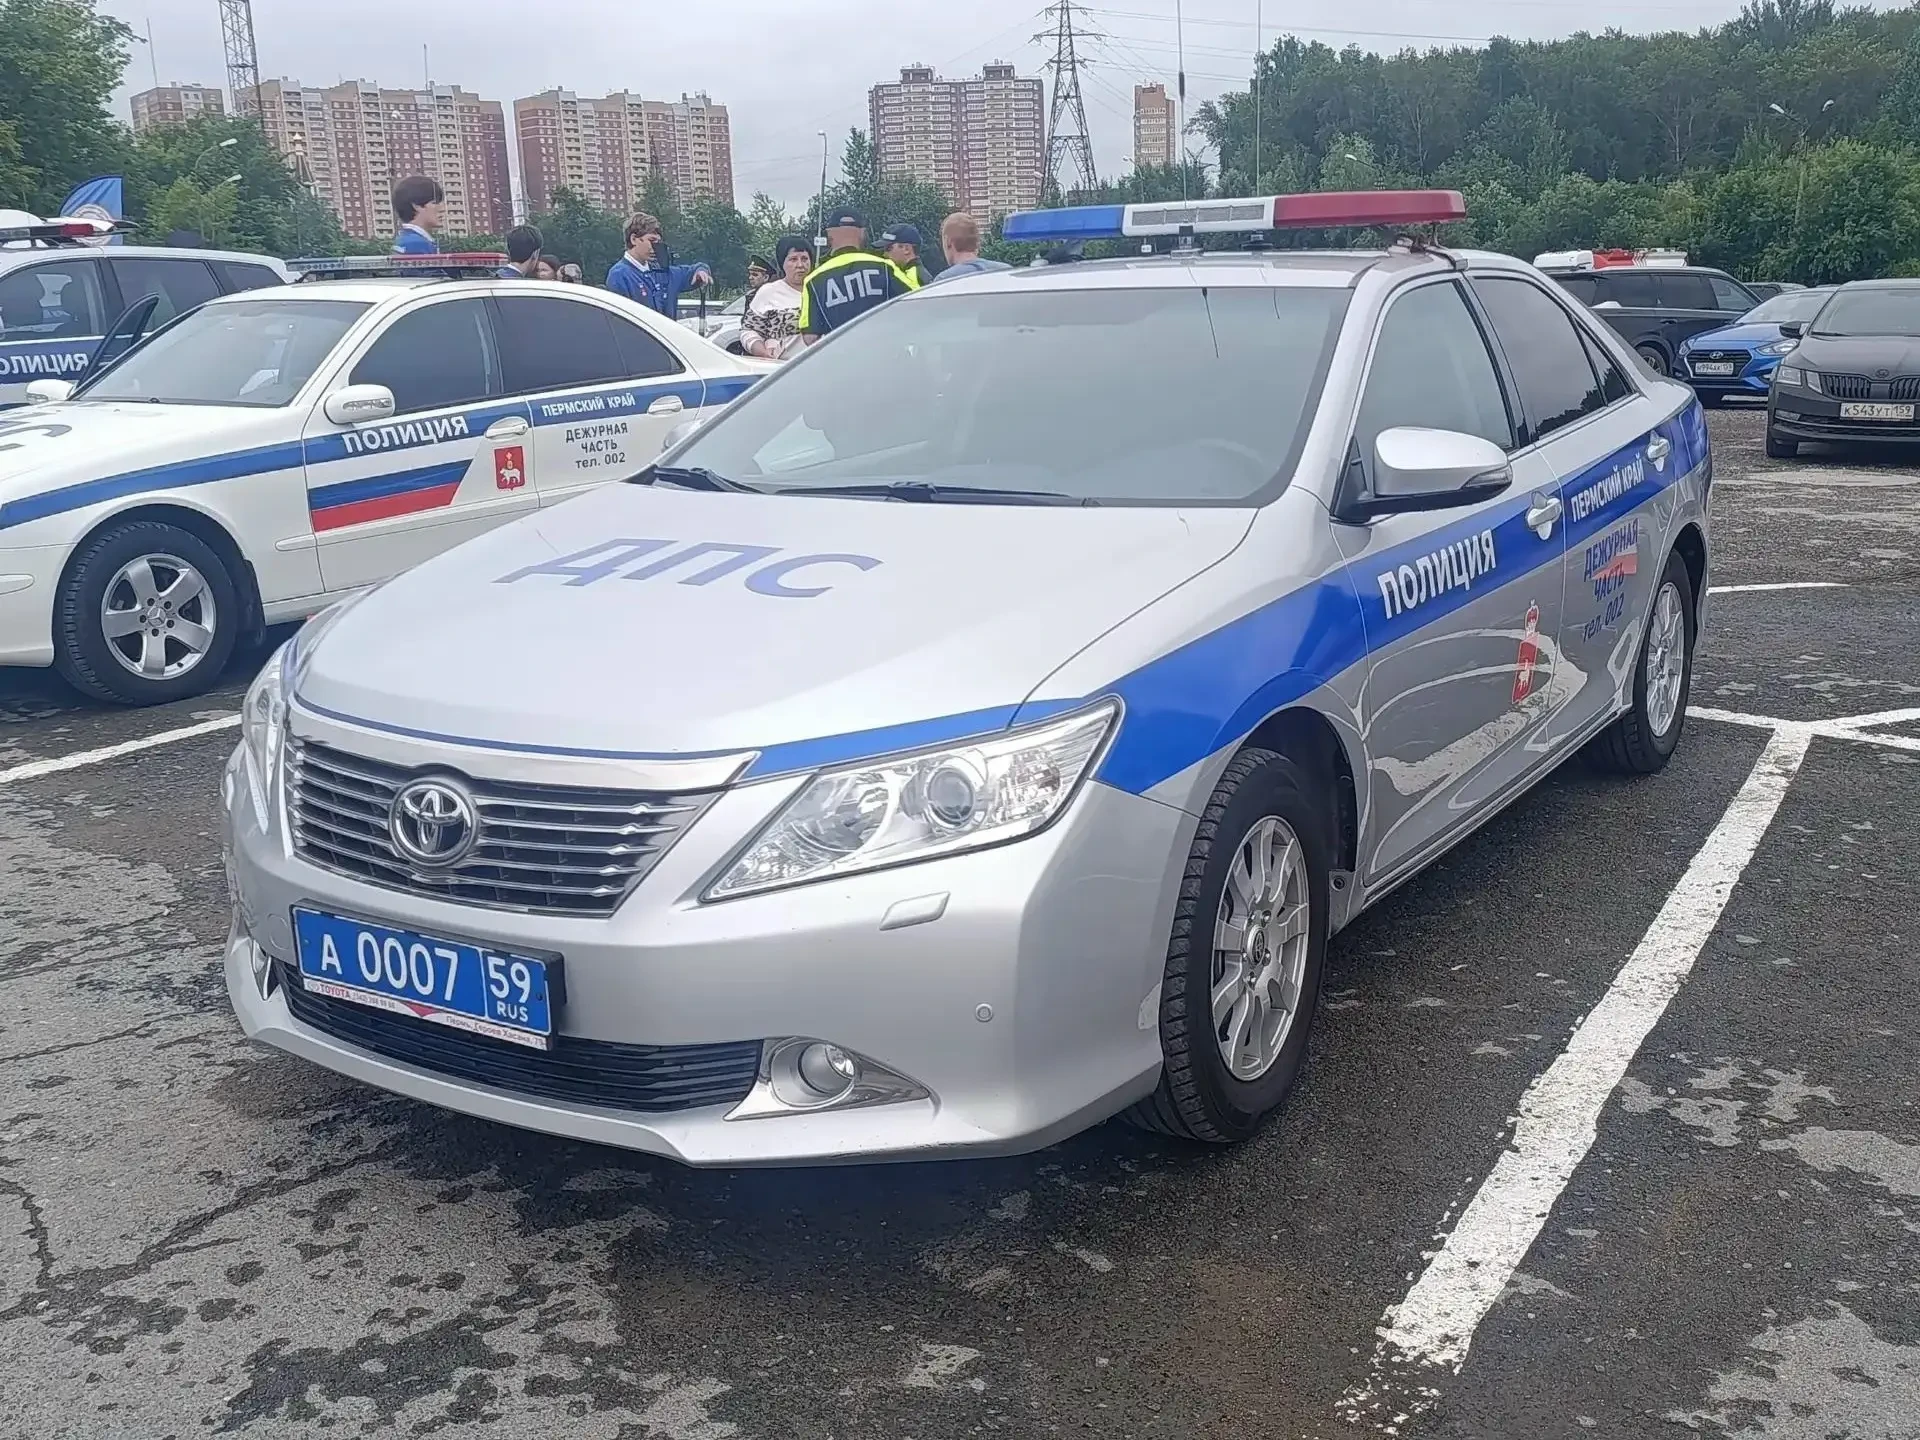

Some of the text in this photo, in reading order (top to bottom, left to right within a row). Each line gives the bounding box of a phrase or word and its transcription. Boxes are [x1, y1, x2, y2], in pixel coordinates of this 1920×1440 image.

[825, 268, 883, 308] ДПС
[0, 353, 89, 376] ОЛИЦИЯ
[541, 392, 636, 417] ПЕРМСКИЙ КРАЙ
[1844, 404, 1911, 416] К543УТ 159
[341, 415, 470, 454] ПОЛИЦИЯ
[566, 422, 629, 443] ДЕЖУРНАЯ
[581, 439, 618, 454] ЧАСТЬ
[575, 452, 626, 469] тел. 002
[1571, 452, 1645, 523] ПЕРМСКИЙ КРАЙ
[491, 538, 884, 598] ДПС
[1583, 517, 1640, 583] ДЕЖУРНАЯ
[1377, 528, 1497, 620] ПОЛИЦИЯ
[1594, 562, 1625, 603] ЧАСТЬ
[1583, 592, 1625, 644] тел. 002
[321, 931, 531, 1004] А 0007 59
[320, 984, 350, 999] TOYOTA
[496, 1000, 529, 1022] RUS
